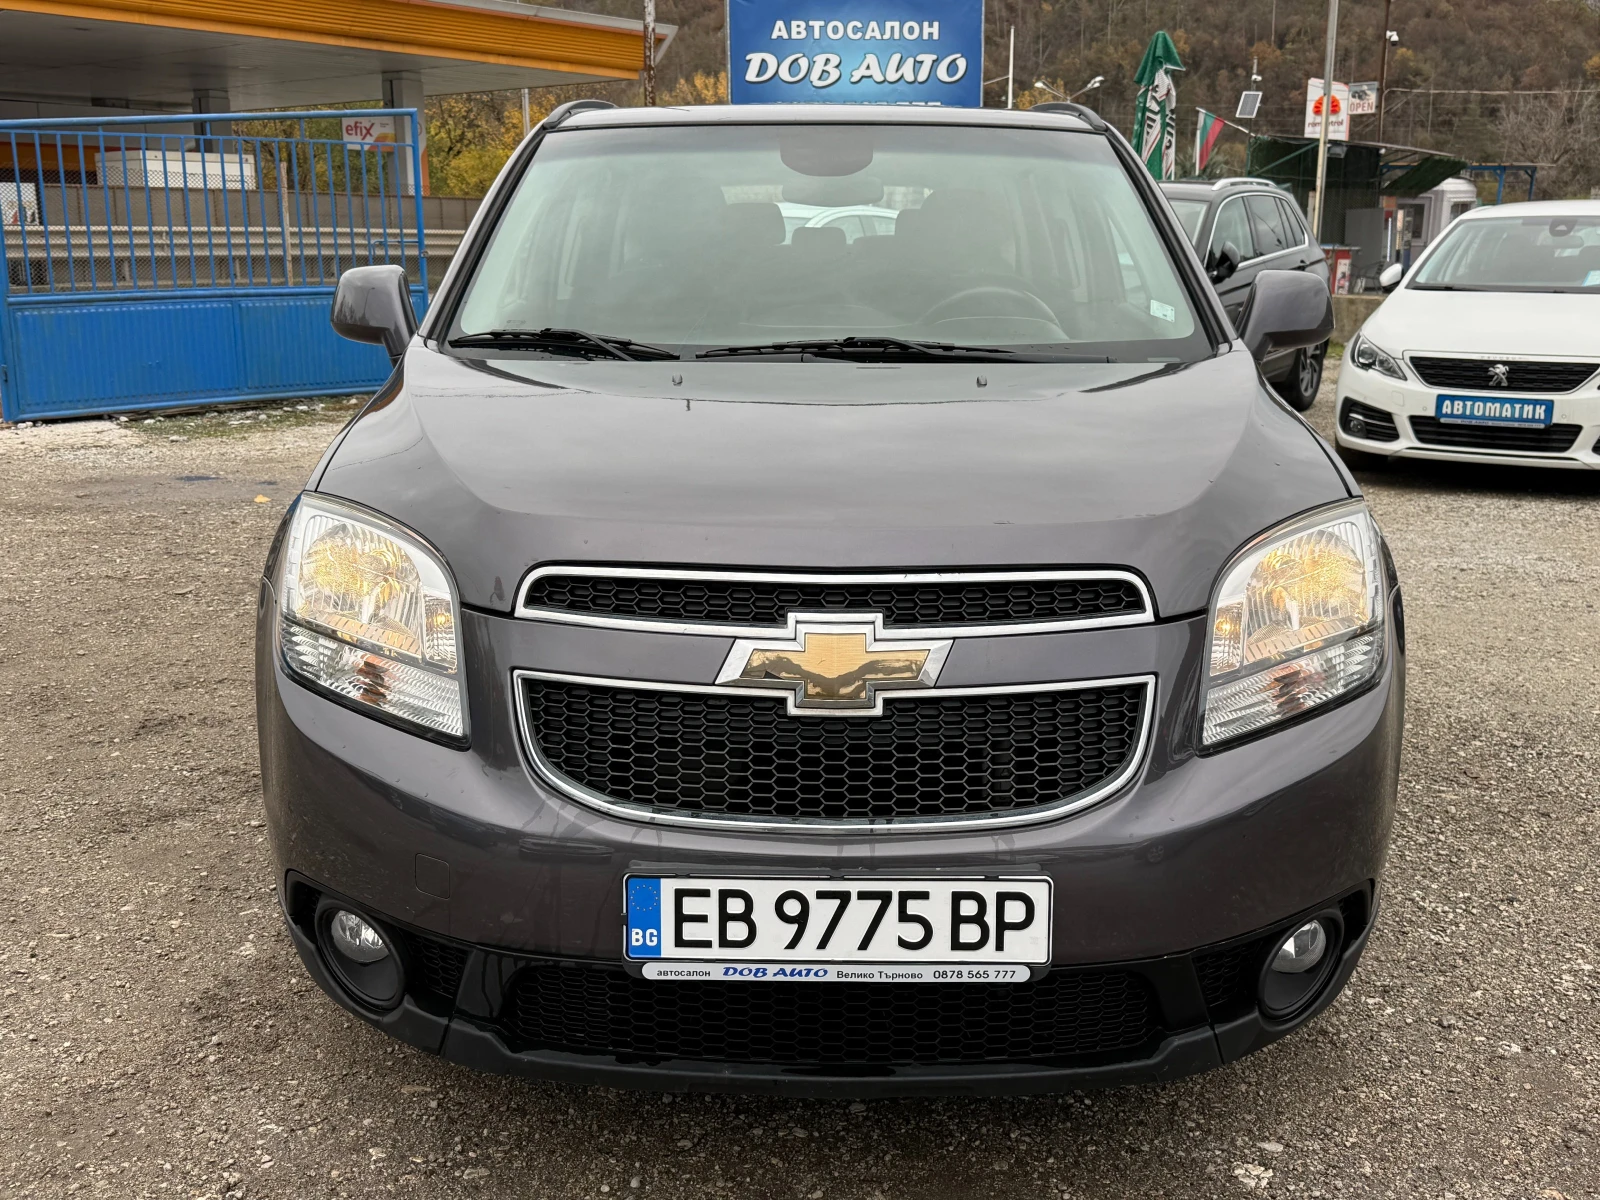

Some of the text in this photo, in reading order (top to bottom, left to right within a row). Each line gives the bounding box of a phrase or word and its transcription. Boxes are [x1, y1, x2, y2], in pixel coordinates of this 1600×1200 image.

[771, 20, 940, 40] АВТОСАЛОН
[745, 52, 967, 88] DOB AUTO
[1349, 101, 1374, 112] OPEN
[345, 121, 375, 141] efix
[1307, 118, 1344, 128] romtrol
[1442, 400, 1546, 419] АВТОМАТИК
[774, 890, 934, 950] 9775
[631, 929, 658, 947] BG
[656, 966, 1016, 981] автосалон DOB AUTO Велико Търново 0878 565 777
